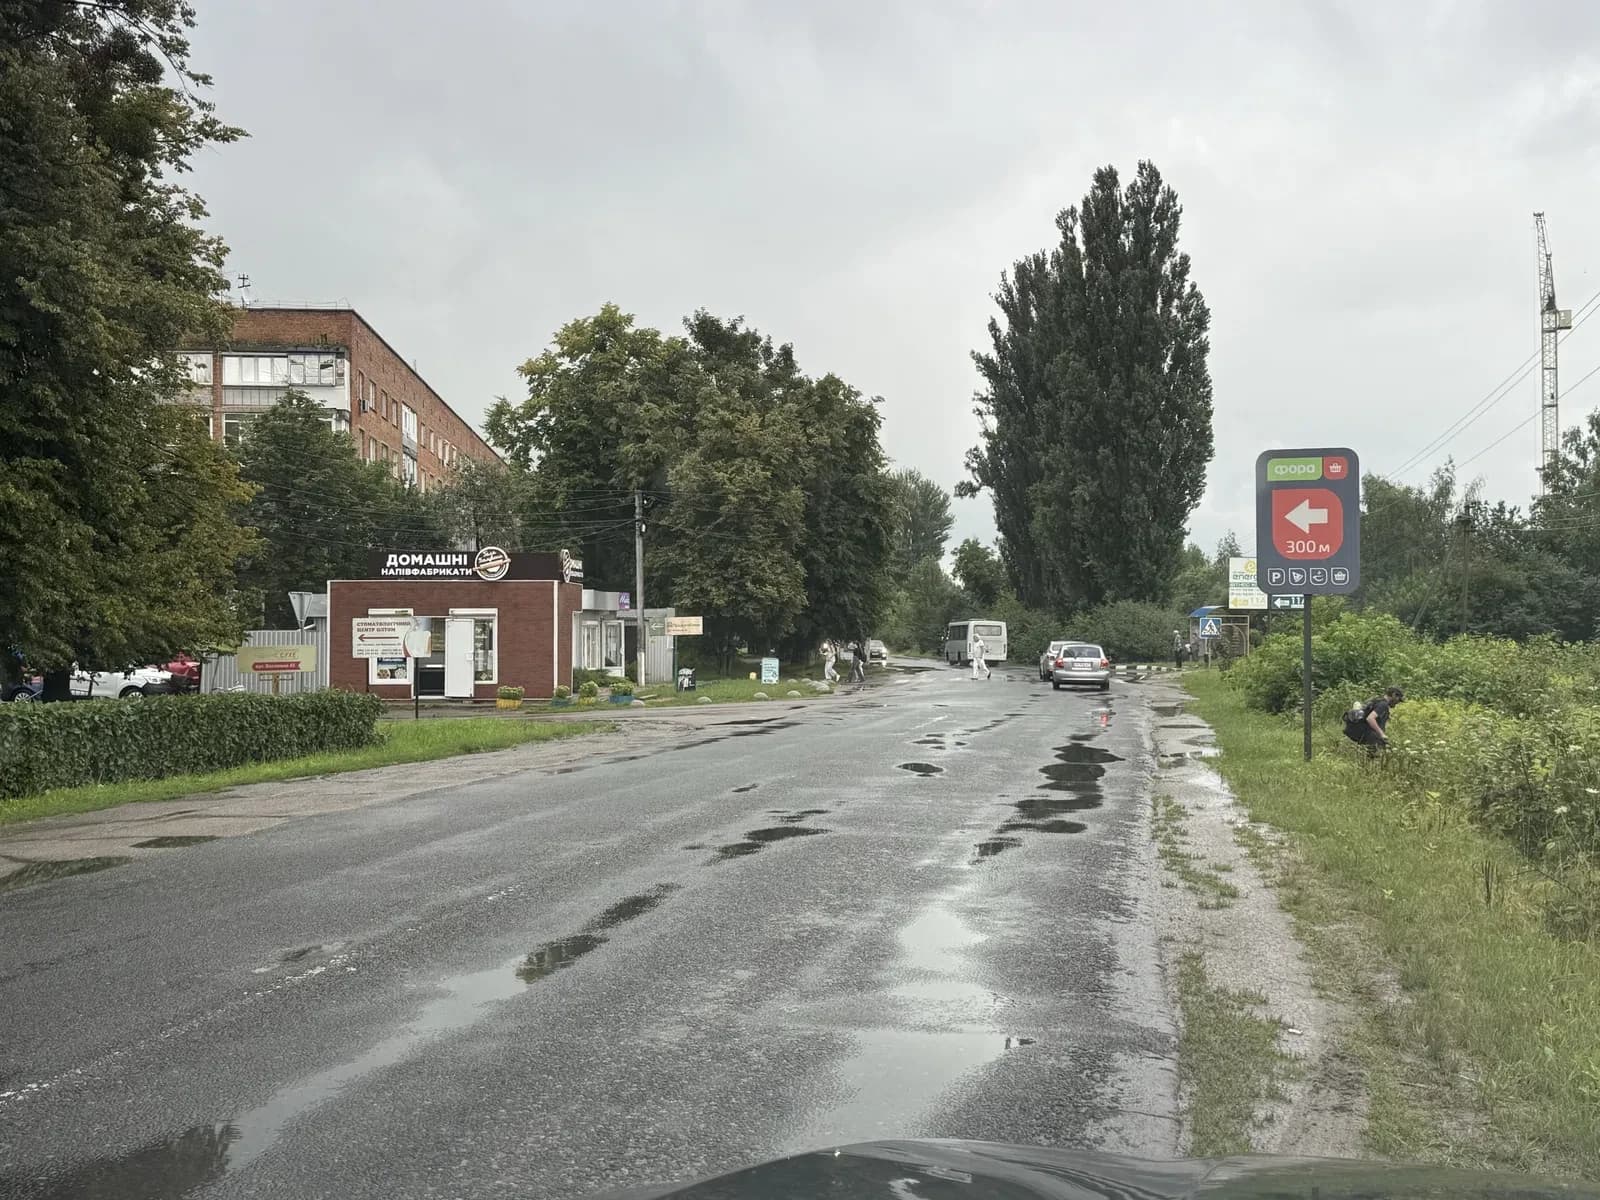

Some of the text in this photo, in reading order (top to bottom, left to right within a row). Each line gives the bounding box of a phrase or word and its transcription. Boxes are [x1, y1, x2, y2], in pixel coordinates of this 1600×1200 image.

[1274, 463, 1315, 475] фора
[1285, 540, 1330, 553] 300 м
[386, 553, 468, 568] ДОМАШНІ
[381, 567, 473, 576] НАПІВФАБРИКАТИ
